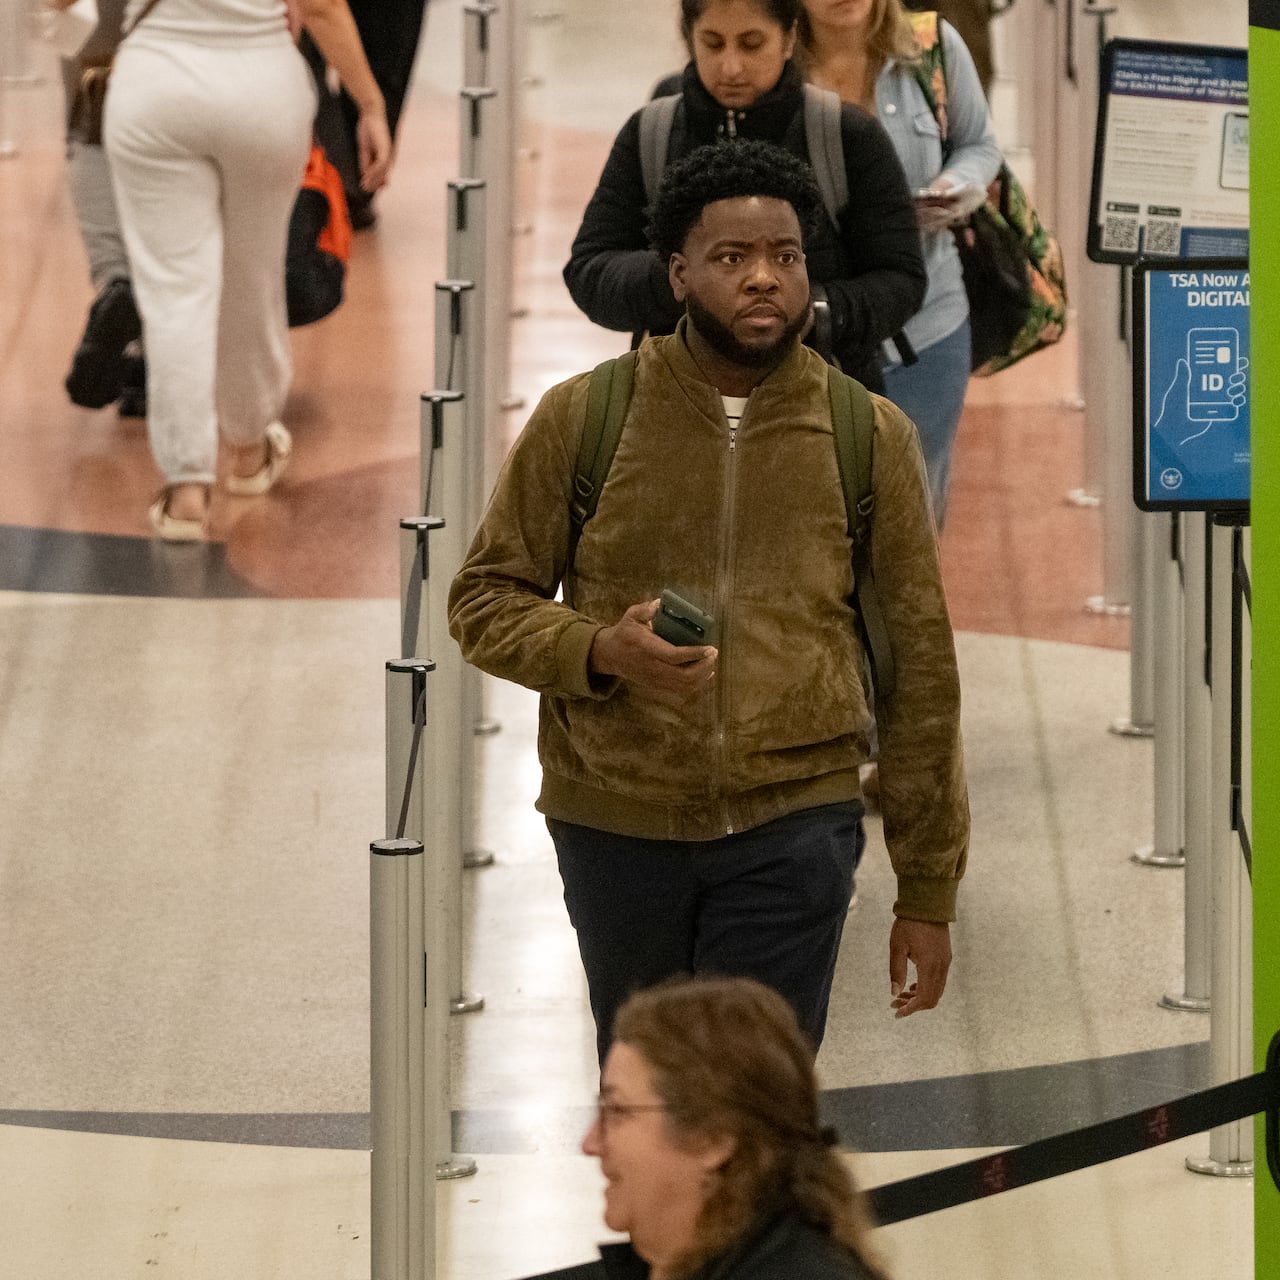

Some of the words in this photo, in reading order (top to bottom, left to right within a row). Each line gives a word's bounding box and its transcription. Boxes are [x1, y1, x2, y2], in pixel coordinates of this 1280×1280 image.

[1169, 273, 1199, 288] TSA
[1202, 273, 1238, 288] Now
[1202, 374, 1224, 392] ID
